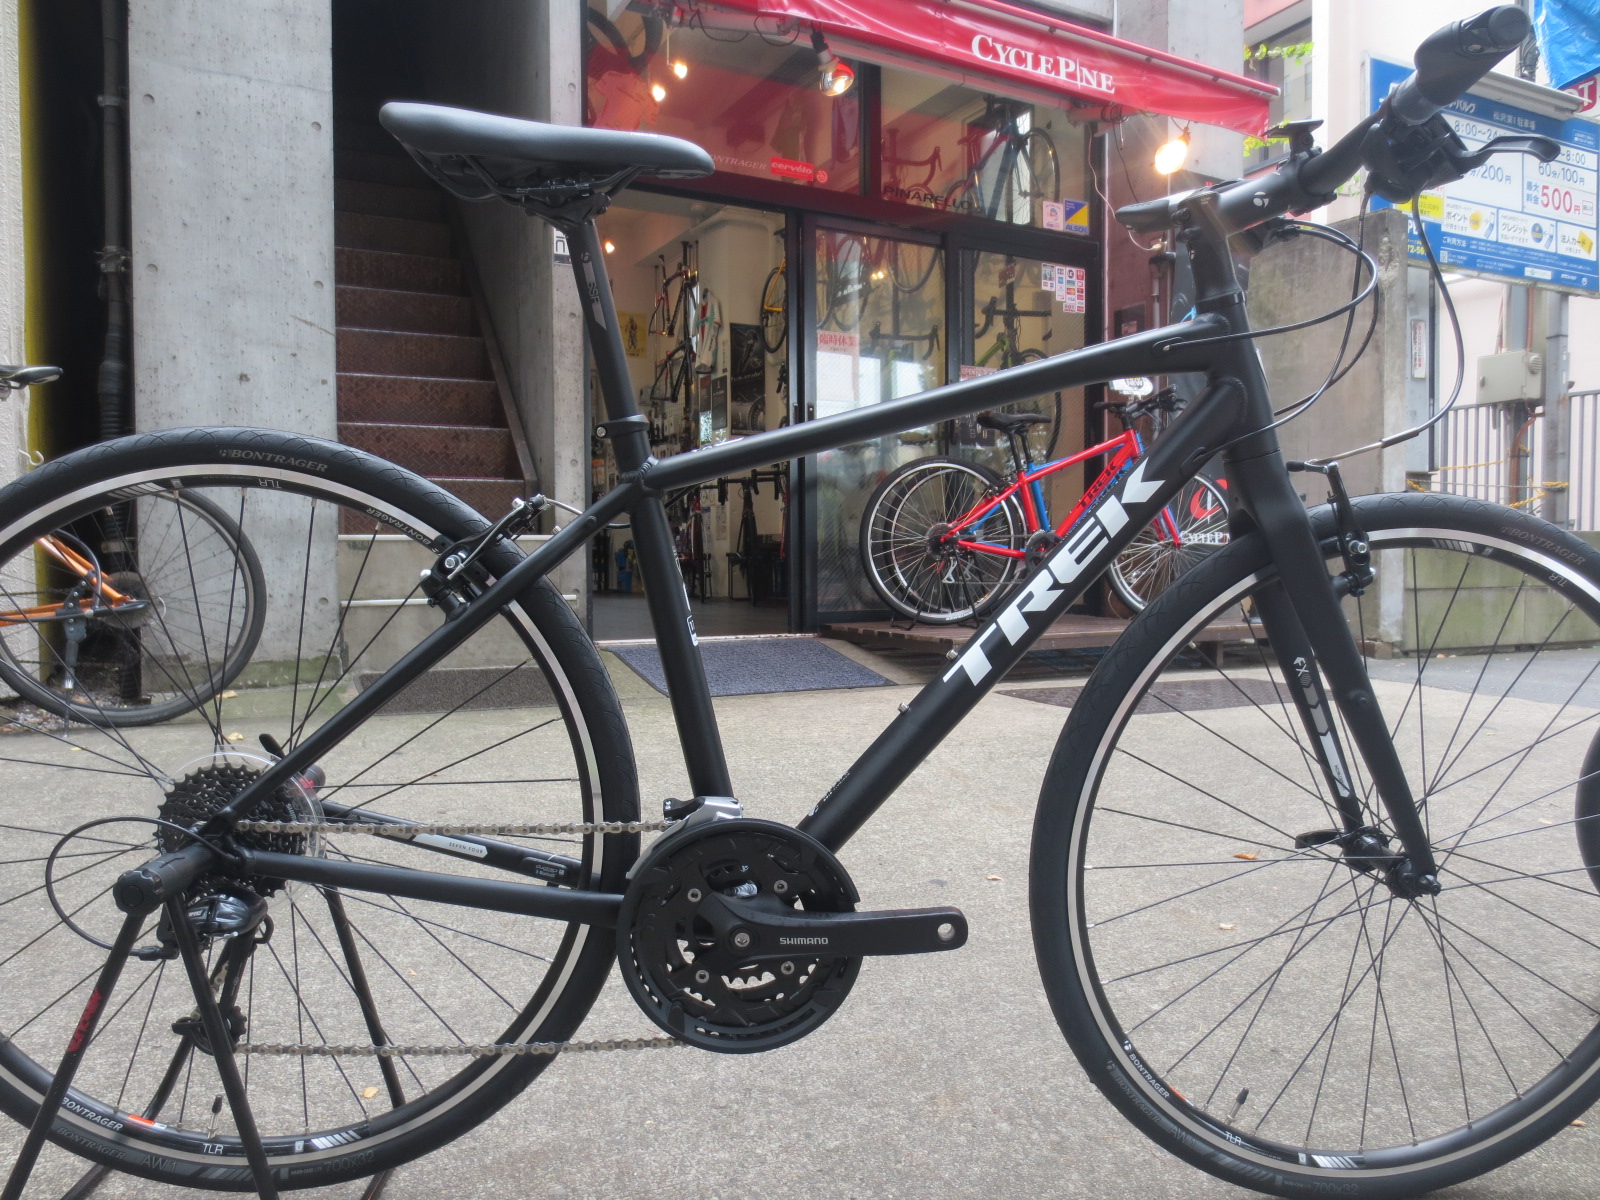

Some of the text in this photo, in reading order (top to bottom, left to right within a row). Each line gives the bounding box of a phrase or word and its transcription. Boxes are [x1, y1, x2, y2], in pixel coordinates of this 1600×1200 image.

[1470, 164, 1512, 185] 分/200円
[231, 449, 328, 472] BONTRAGER
[257, 478, 282, 489] TLR
[366, 507, 431, 546] BONTRAGER
[1510, 528, 1586, 566] BONTRAGER
[943, 456, 1167, 687] TREK
[448, 841, 467, 850] SEVEN
[779, 936, 829, 946] SHIMANO
[1129, 1053, 1170, 1099] BONTRAGER
[1114, 1075, 1163, 1123] BONTRAGER
[56, 1126, 128, 1160] BONTRAGER
[202, 1142, 224, 1155] TLR
[323, 1149, 375, 1174] 700x32
[1312, 1181, 1360, 1196] 700x32
